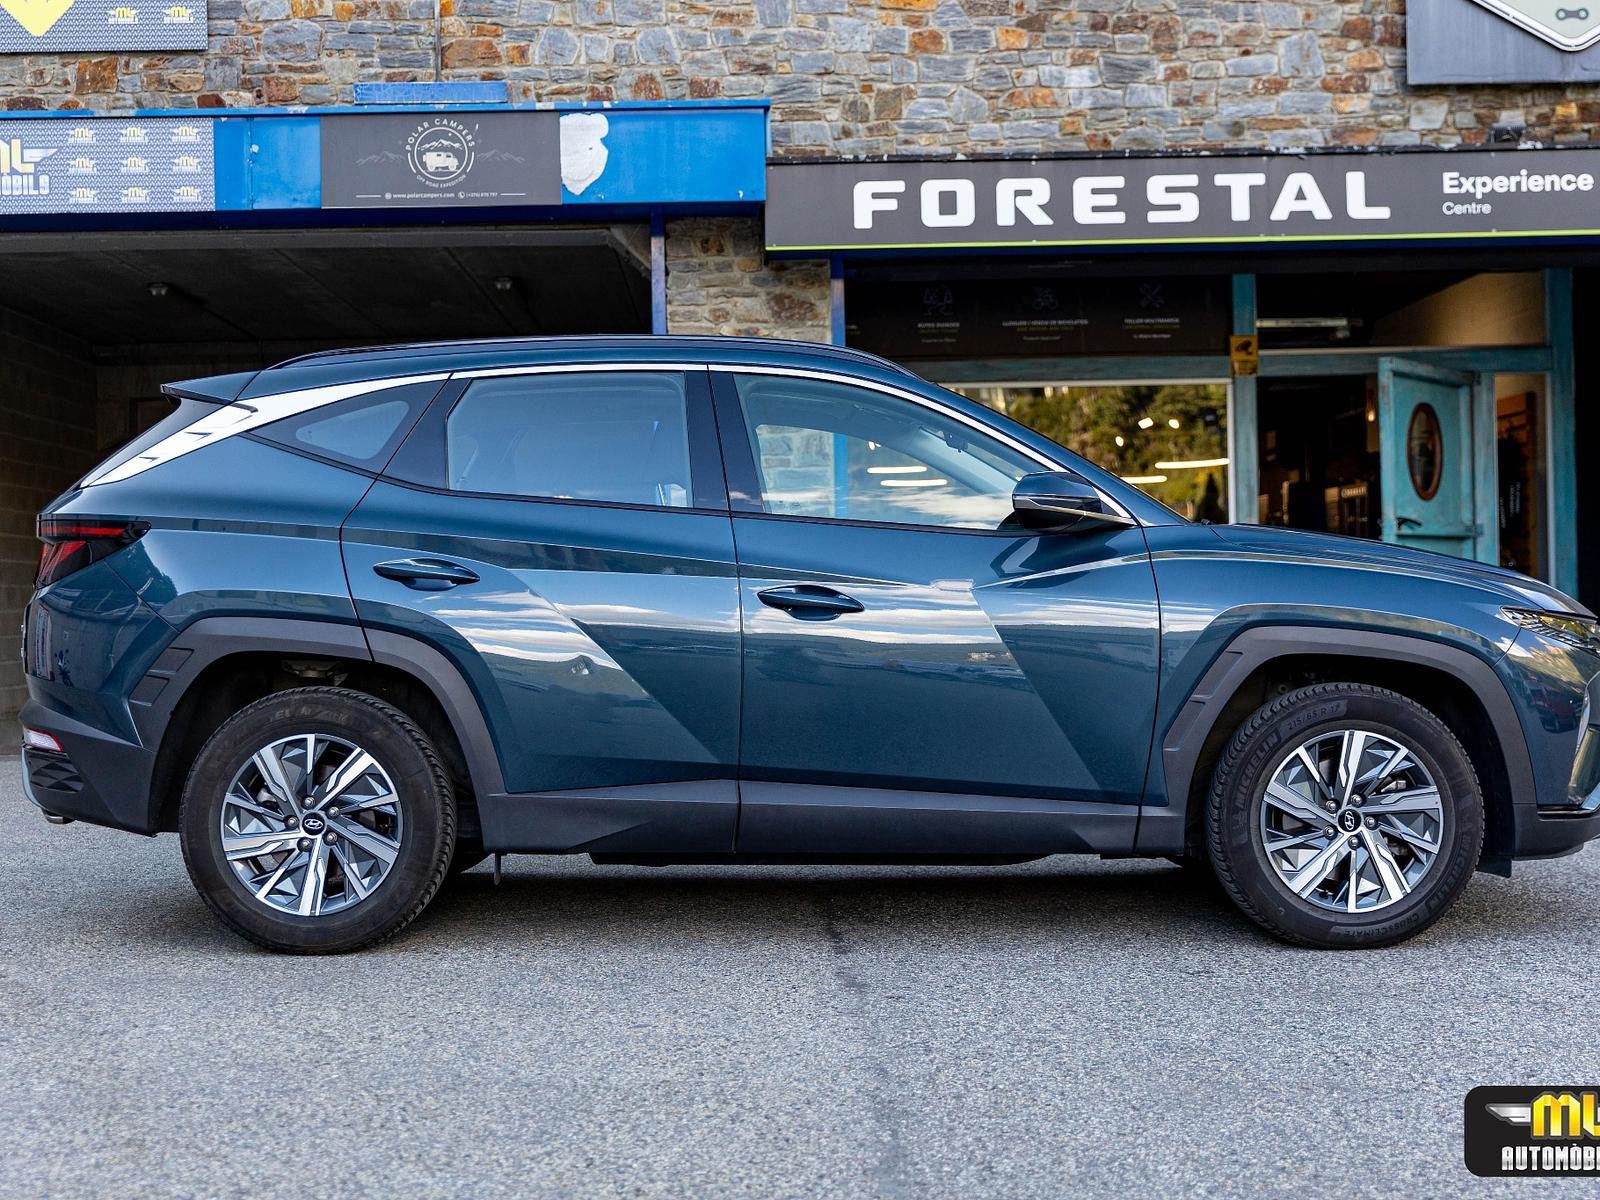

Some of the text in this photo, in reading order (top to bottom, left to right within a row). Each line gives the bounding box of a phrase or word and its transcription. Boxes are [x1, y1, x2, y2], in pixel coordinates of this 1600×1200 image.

[405, 118, 476, 151] POLAR CAMPERS
[853, 170, 1391, 230] FORESTAL
[1442, 168, 1595, 200] Experience
[1442, 200, 1492, 216] Centre
[1234, 730, 1279, 808] MICHELIN
